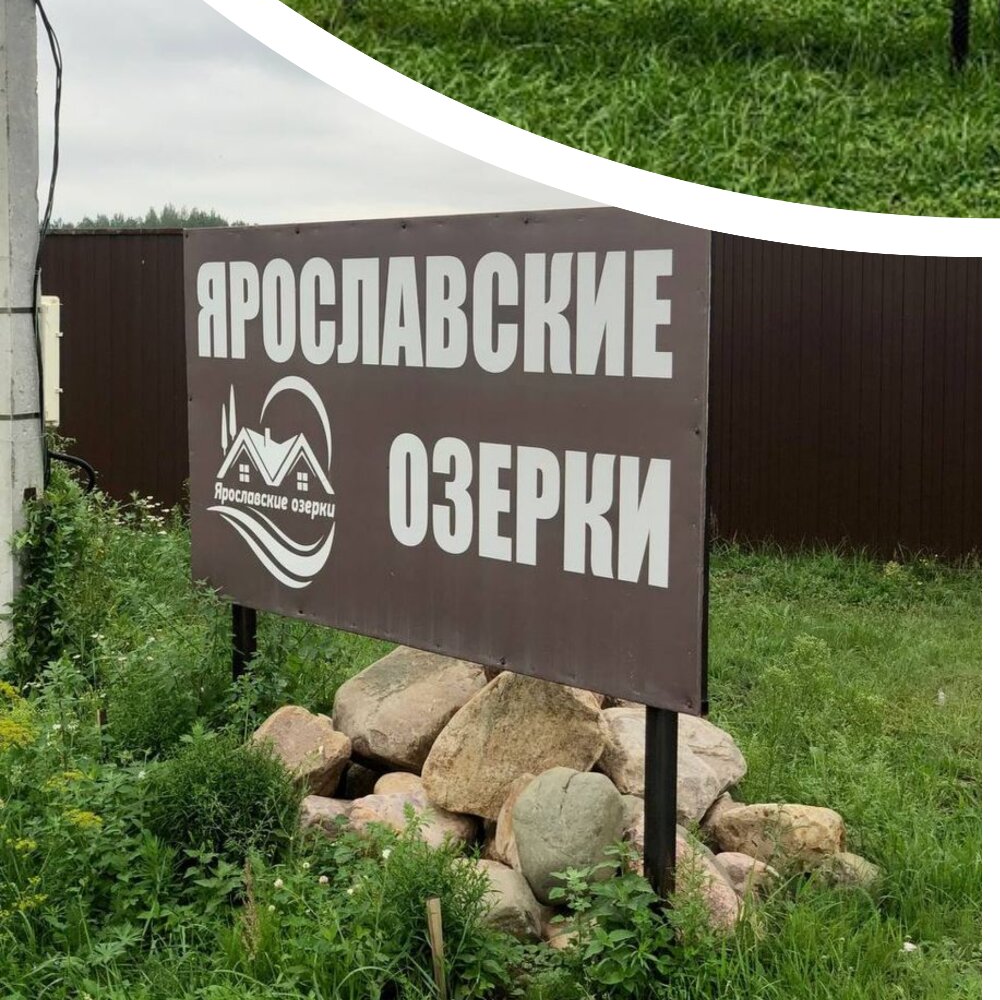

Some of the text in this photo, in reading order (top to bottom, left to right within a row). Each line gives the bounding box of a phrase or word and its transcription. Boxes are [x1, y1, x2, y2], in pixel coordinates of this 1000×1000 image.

[198, 248, 673, 380] ЯРОСЛАВСКИЕ
[214, 482, 336, 521] Ярославские озерки
[388, 432, 672, 589] ОЗЕРКИ
